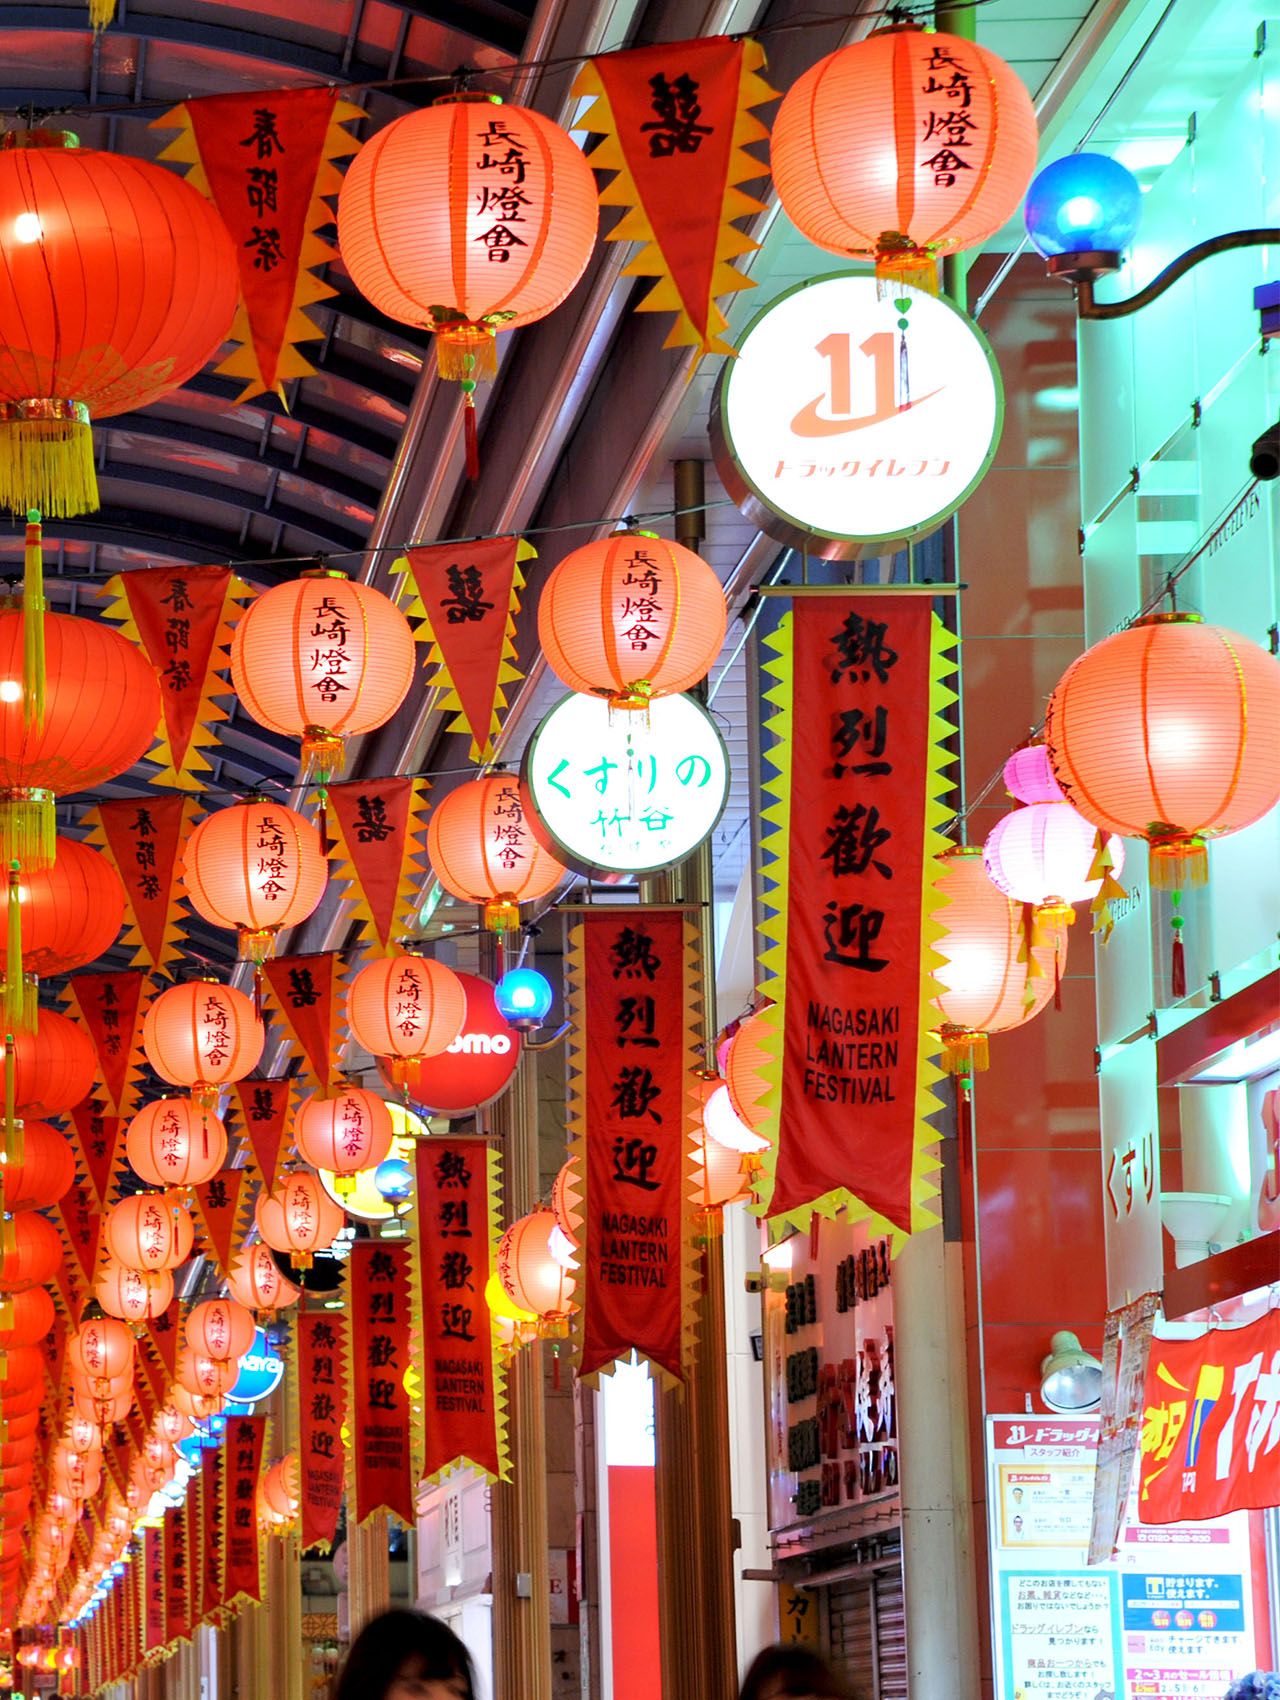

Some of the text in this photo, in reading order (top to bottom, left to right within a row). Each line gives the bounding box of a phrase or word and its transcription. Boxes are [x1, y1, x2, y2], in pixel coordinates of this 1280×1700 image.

[922, 45, 977, 188] 長崎燈會
[475, 119, 532, 264] 長崎燈會
[620, 550, 663, 652] 長崎燈會
[311, 597, 351, 703] 長崎燈會
[547, 754, 711, 799] くすりの
[821, 610, 898, 973] 熱烈歡迎
[590, 807, 674, 838] 竹谷
[255, 816, 288, 902] 長崎燈會
[395, 968, 424, 1037] 長崎燈會
[807, 1000, 900, 1036] NAGASAKI
[204, 996, 232, 1067] 長崎燈會
[806, 1033, 898, 1069] LANTERN
[609, 925, 663, 1193] 熱烈歡迎
[804, 1072, 895, 1104] FESTIVAL
[602, 1211, 667, 1236] NAGASAKI
[435, 1150, 476, 1343] 熱烈歡迎
[601, 1240, 668, 1264] LANTERN
[600, 1262, 667, 1289] FESTIVAL
[367, 1250, 399, 1411] 熱烈歡迎
[435, 1358, 484, 1377] NAGASAKI
[435, 1378, 485, 1395] LANTERN
[435, 1395, 485, 1414] FESTIVAL
[1030, 1447, 1081, 1458] スタッフ紹介
